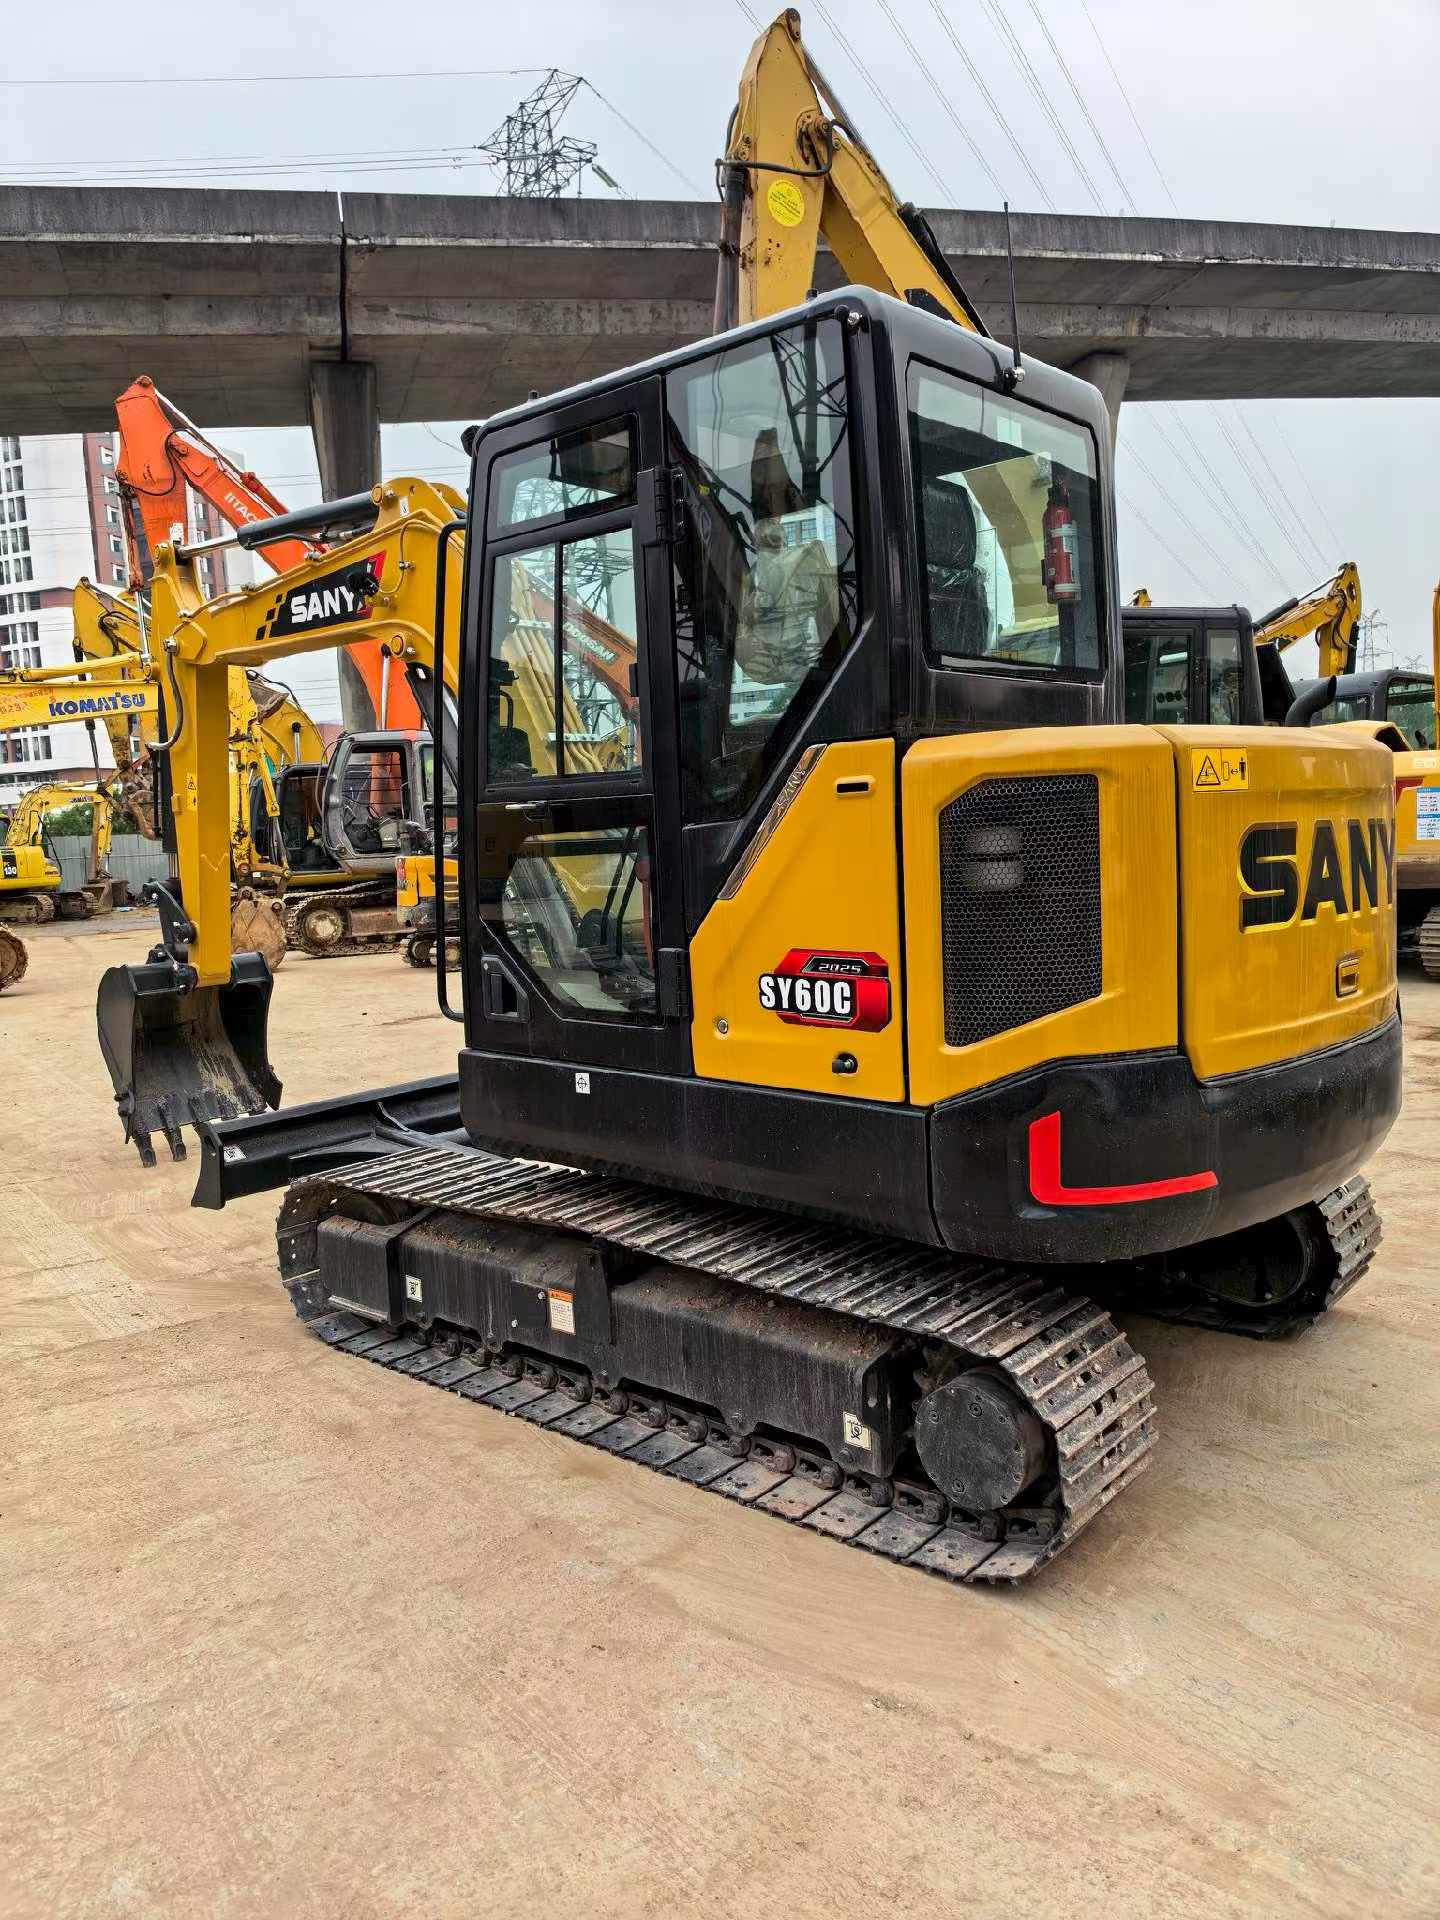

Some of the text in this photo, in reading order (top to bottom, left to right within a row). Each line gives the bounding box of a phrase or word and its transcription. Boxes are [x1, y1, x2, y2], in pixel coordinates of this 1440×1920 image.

[291, 586, 355, 623] SANY
[49, 692, 145, 716] KOMATSU
[1238, 819, 1395, 933] SANY
[818, 962, 861, 974] 2025
[760, 976, 851, 1015] SY60C
